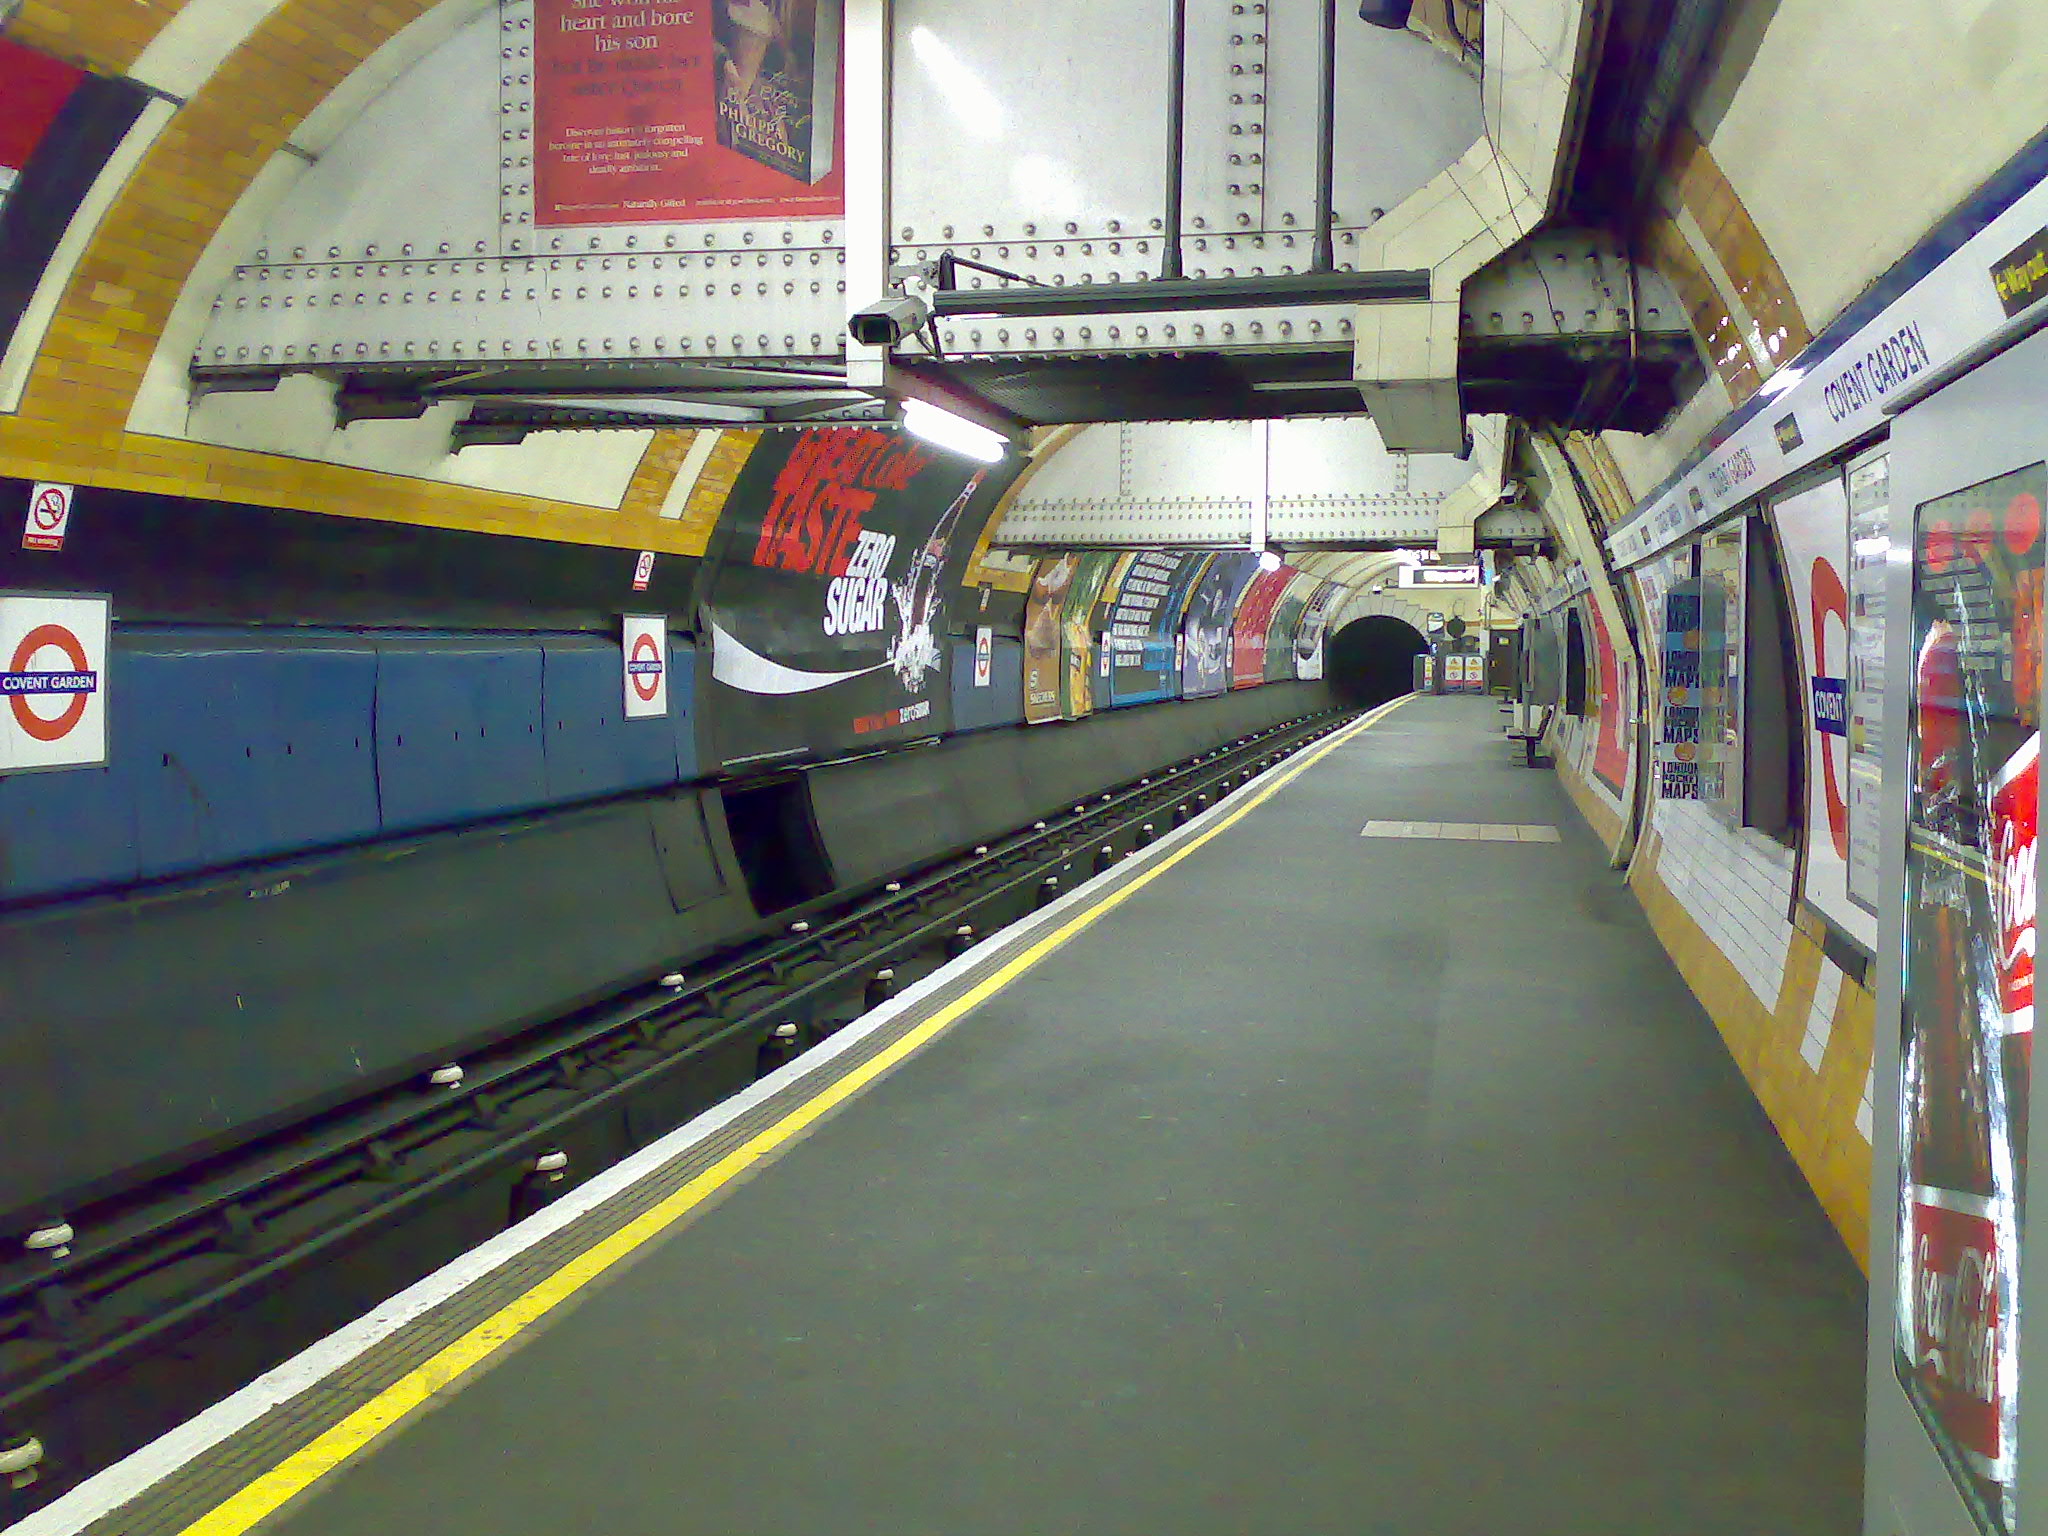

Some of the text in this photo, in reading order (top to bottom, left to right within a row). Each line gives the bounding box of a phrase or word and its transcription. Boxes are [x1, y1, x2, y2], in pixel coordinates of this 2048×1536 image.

[560, 8, 695, 32] heart and bore
[594, 34, 659, 51] his son
[719, 101, 787, 141] PHILIPPA
[735, 122, 806, 163] GREGORY
[1824, 320, 1930, 423] COVENT GARDEN
[752, 474, 877, 577] TASTE
[846, 529, 897, 579] ZERO
[823, 576, 889, 636] SUGAR
[2, 675, 95, 690] COVENT GARDEN
[1814, 690, 1844, 722] COVENT
[1664, 726, 1699, 743] MAPS
[1662, 783, 1699, 799] MAPS
